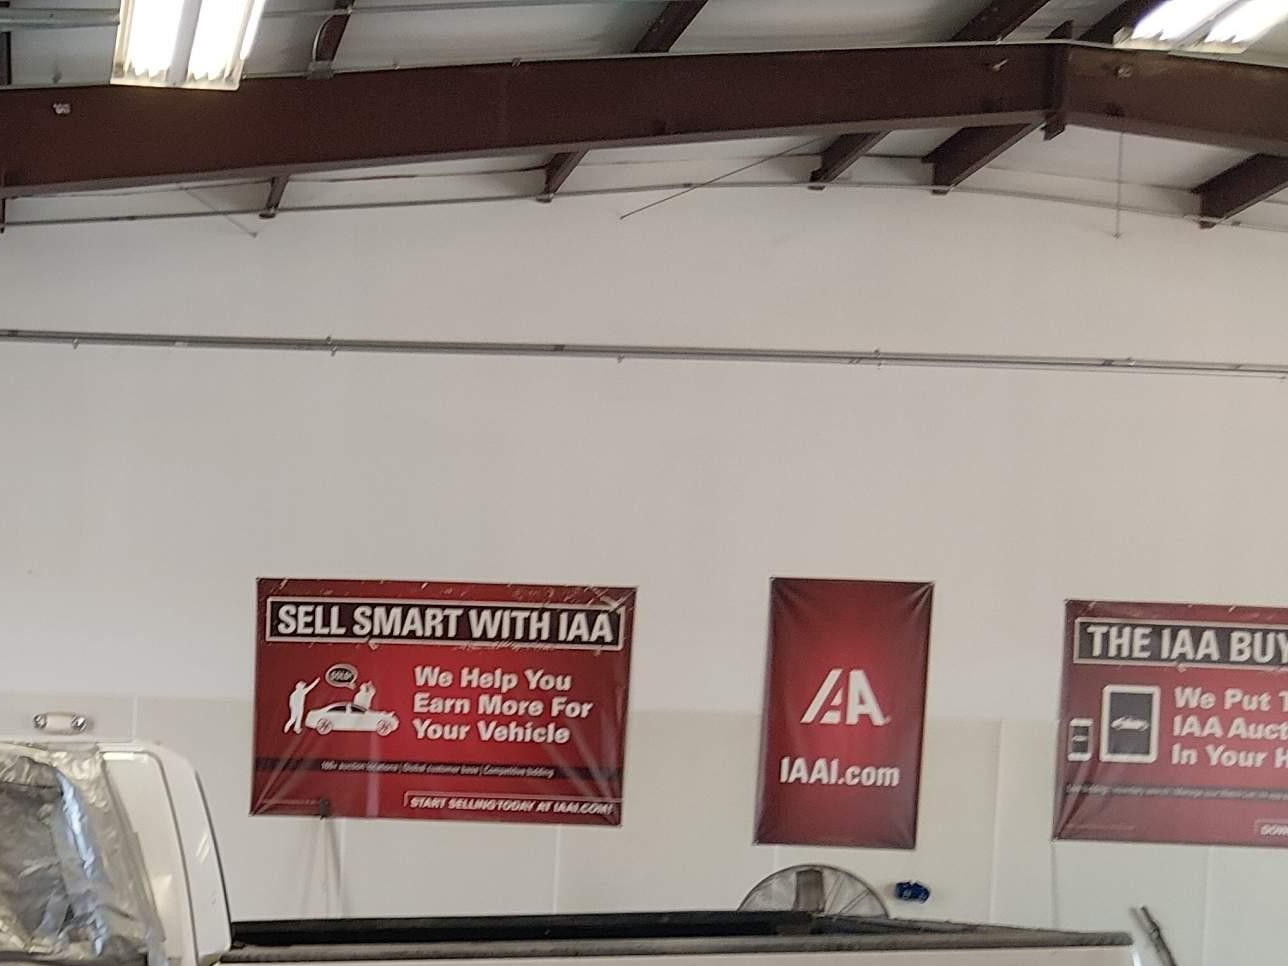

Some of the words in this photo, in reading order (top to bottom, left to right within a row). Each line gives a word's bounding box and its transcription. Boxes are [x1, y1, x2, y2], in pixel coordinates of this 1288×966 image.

[277, 603, 346, 635] SELL
[352, 605, 464, 638] SMART
[468, 608, 551, 641] WITH
[558, 611, 613, 643] IAA
[1087, 625, 1152, 658] THE
[1160, 628, 1220, 662] IAA
[414, 665, 454, 688] We
[460, 666, 518, 694] Help
[524, 668, 572, 692] You
[413, 692, 471, 715] Earn
[477, 694, 544, 717] More
[550, 696, 593, 719] For
[1175, 686, 1216, 709] We
[1224, 688, 1271, 712] Put
[412, 718, 471, 741] Your
[477, 720, 570, 744] Vehicle
[1173, 714, 1223, 738] IAA
[1171, 743, 1198, 765] In
[1207, 744, 1267, 767] Your
[779, 756, 900, 787] IAAI.com
[410, 798, 445, 810] START
[448, 799, 496, 812] SELLING
[498, 800, 537, 813] TODAY
[535, 802, 552, 813] AT
